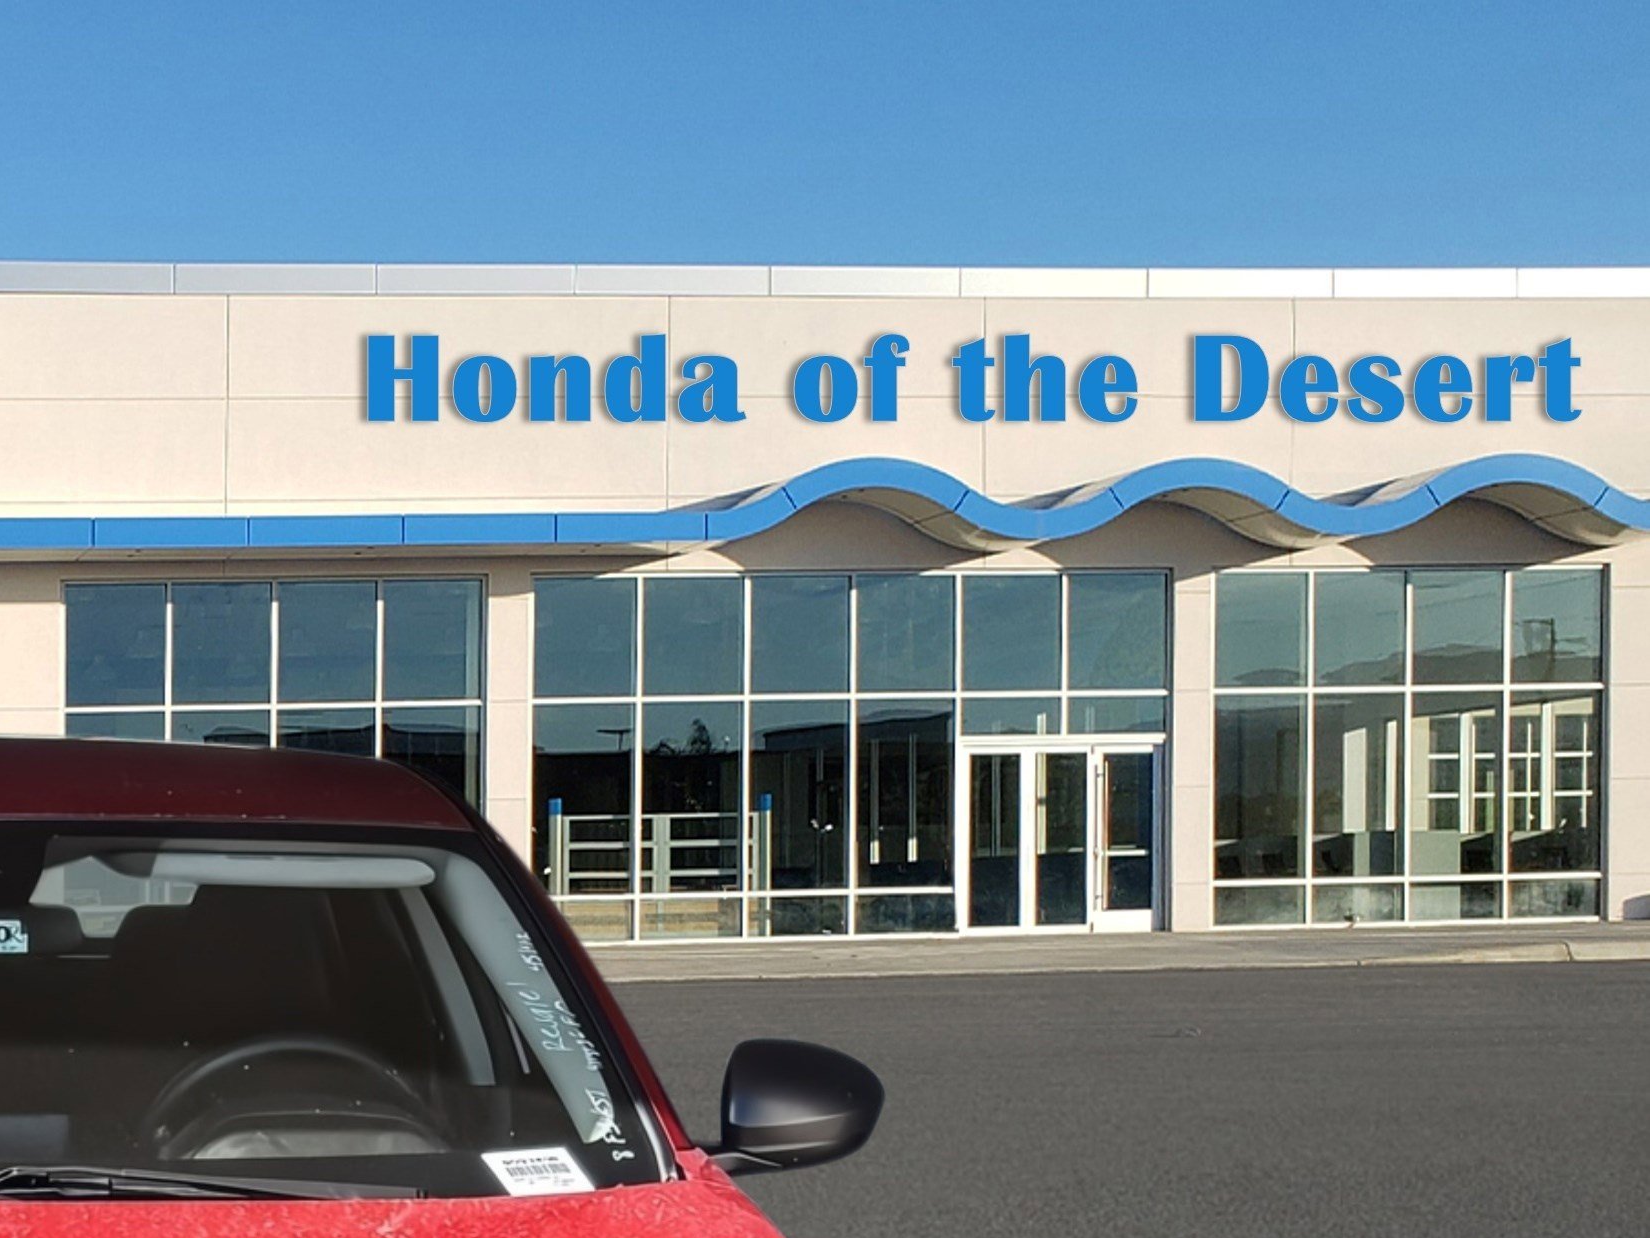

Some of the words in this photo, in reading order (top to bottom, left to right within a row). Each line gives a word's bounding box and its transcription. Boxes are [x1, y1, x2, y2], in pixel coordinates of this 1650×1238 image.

[367, 334, 746, 423] Honda
[793, 333, 910, 423] of
[951, 334, 1139, 423] the
[1194, 334, 1583, 423] Desert
